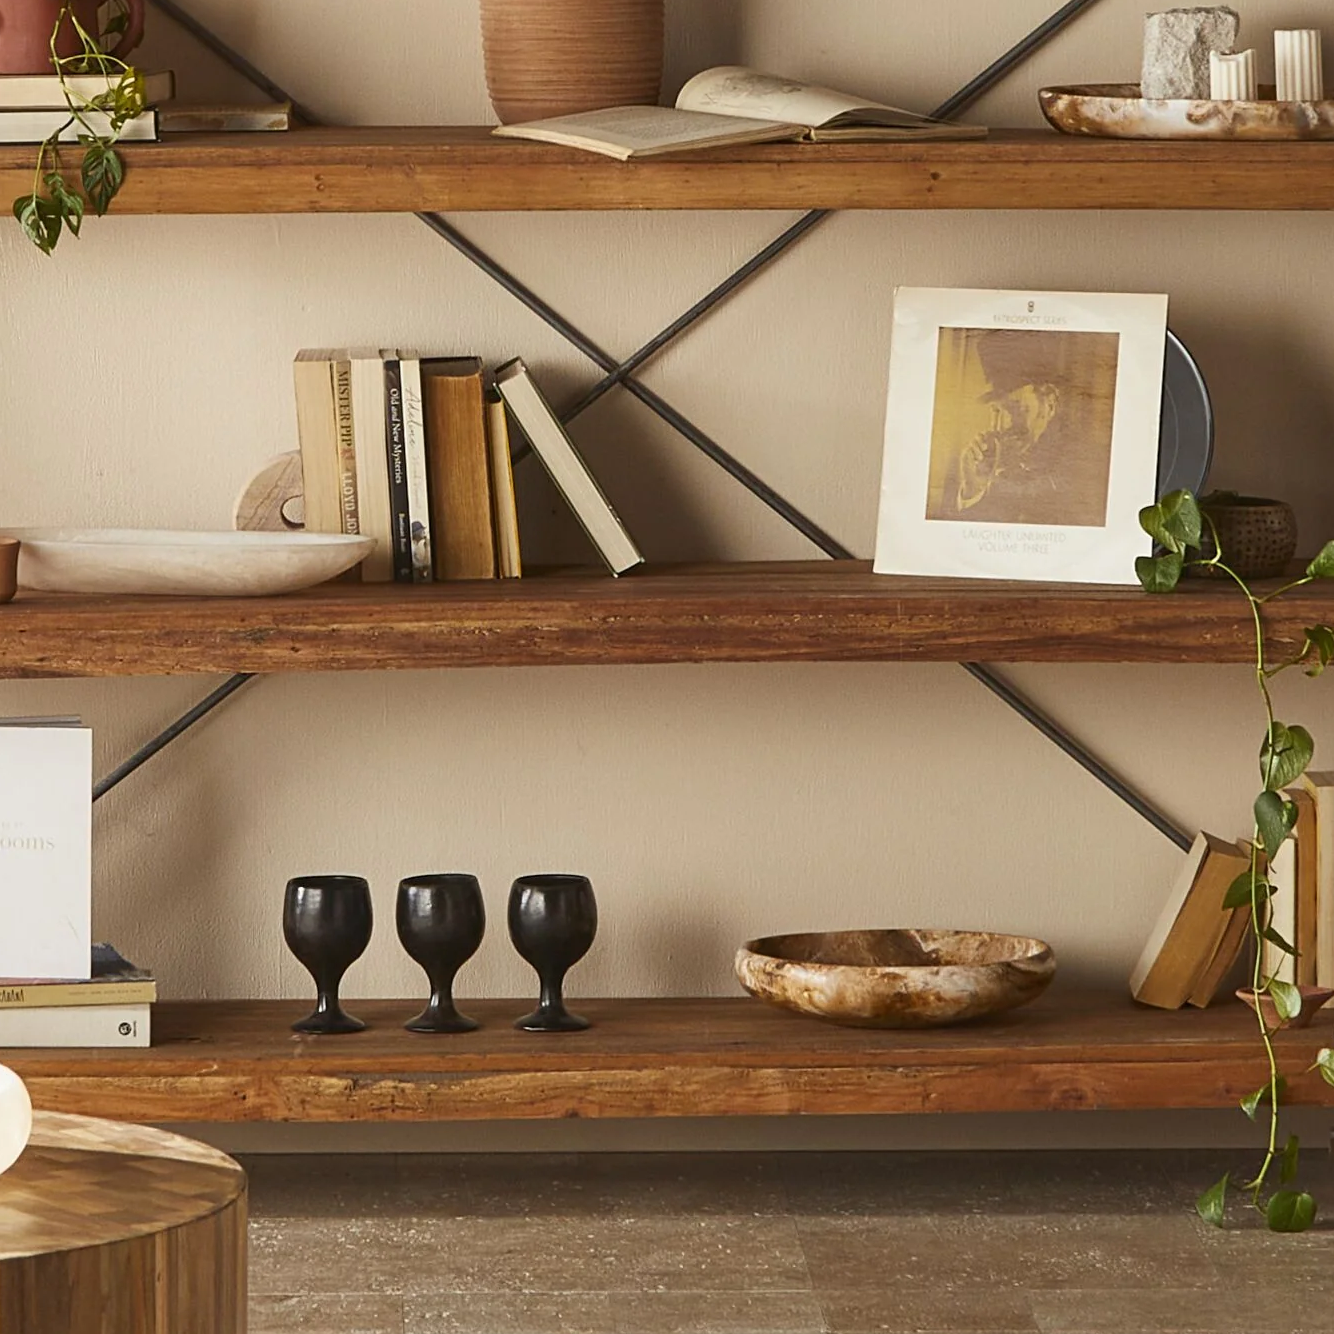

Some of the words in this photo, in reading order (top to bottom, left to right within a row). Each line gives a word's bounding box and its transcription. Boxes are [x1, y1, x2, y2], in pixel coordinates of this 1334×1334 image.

[337, 370, 351, 421] MISTER
[389, 388, 400, 405] Old
[391, 406, 401, 422] and
[340, 425, 352, 447] PIP
[392, 423, 402, 442] New
[391, 444, 403, 484] Mysteries
[342, 472, 355, 510] LLOYD
[962, 529, 1012, 541] LAUGHTER
[977, 542, 1017, 553] VOLUME
[1022, 543, 1049, 554] THREE
